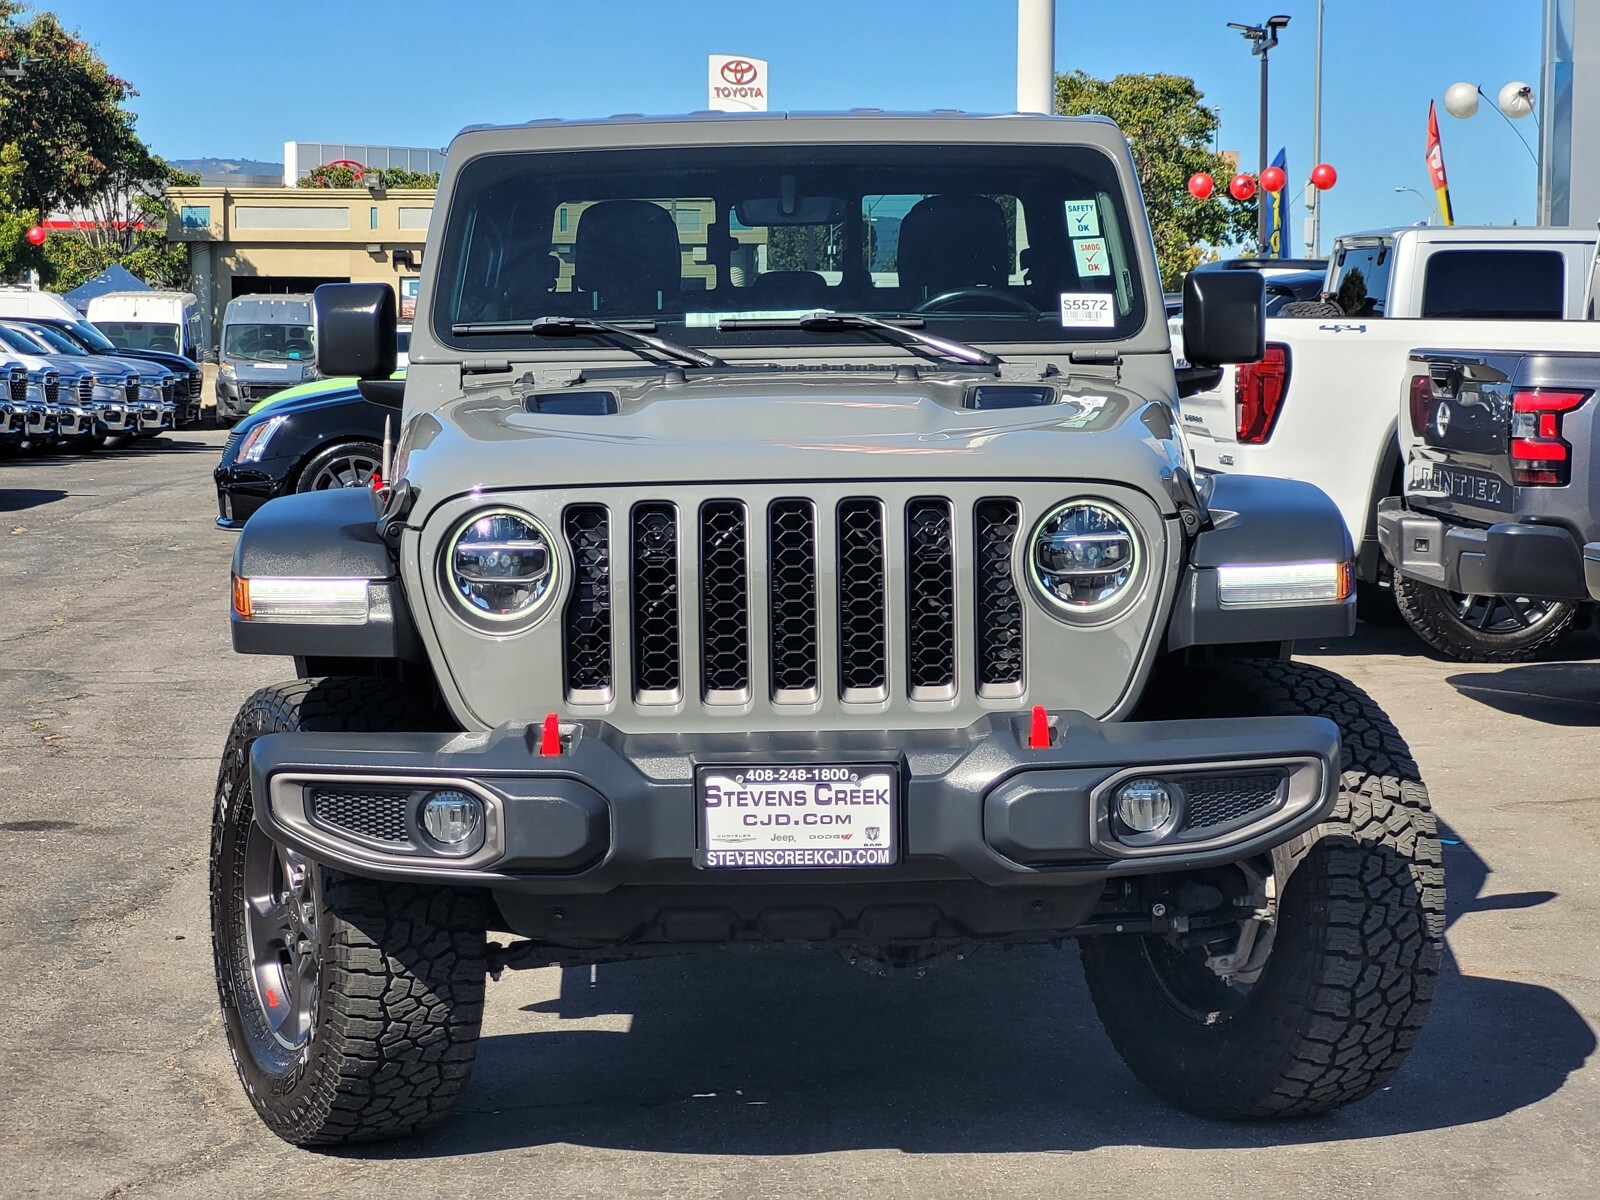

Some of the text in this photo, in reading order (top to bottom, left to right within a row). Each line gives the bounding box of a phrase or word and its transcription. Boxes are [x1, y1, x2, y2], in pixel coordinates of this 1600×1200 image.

[714, 87, 764, 98] TOYOTA
[1063, 299, 1108, 311] S5572
[746, 768, 849, 782] 408-248-1800
[707, 849, 890, 866] STEVENSCREEKCJD.COM
